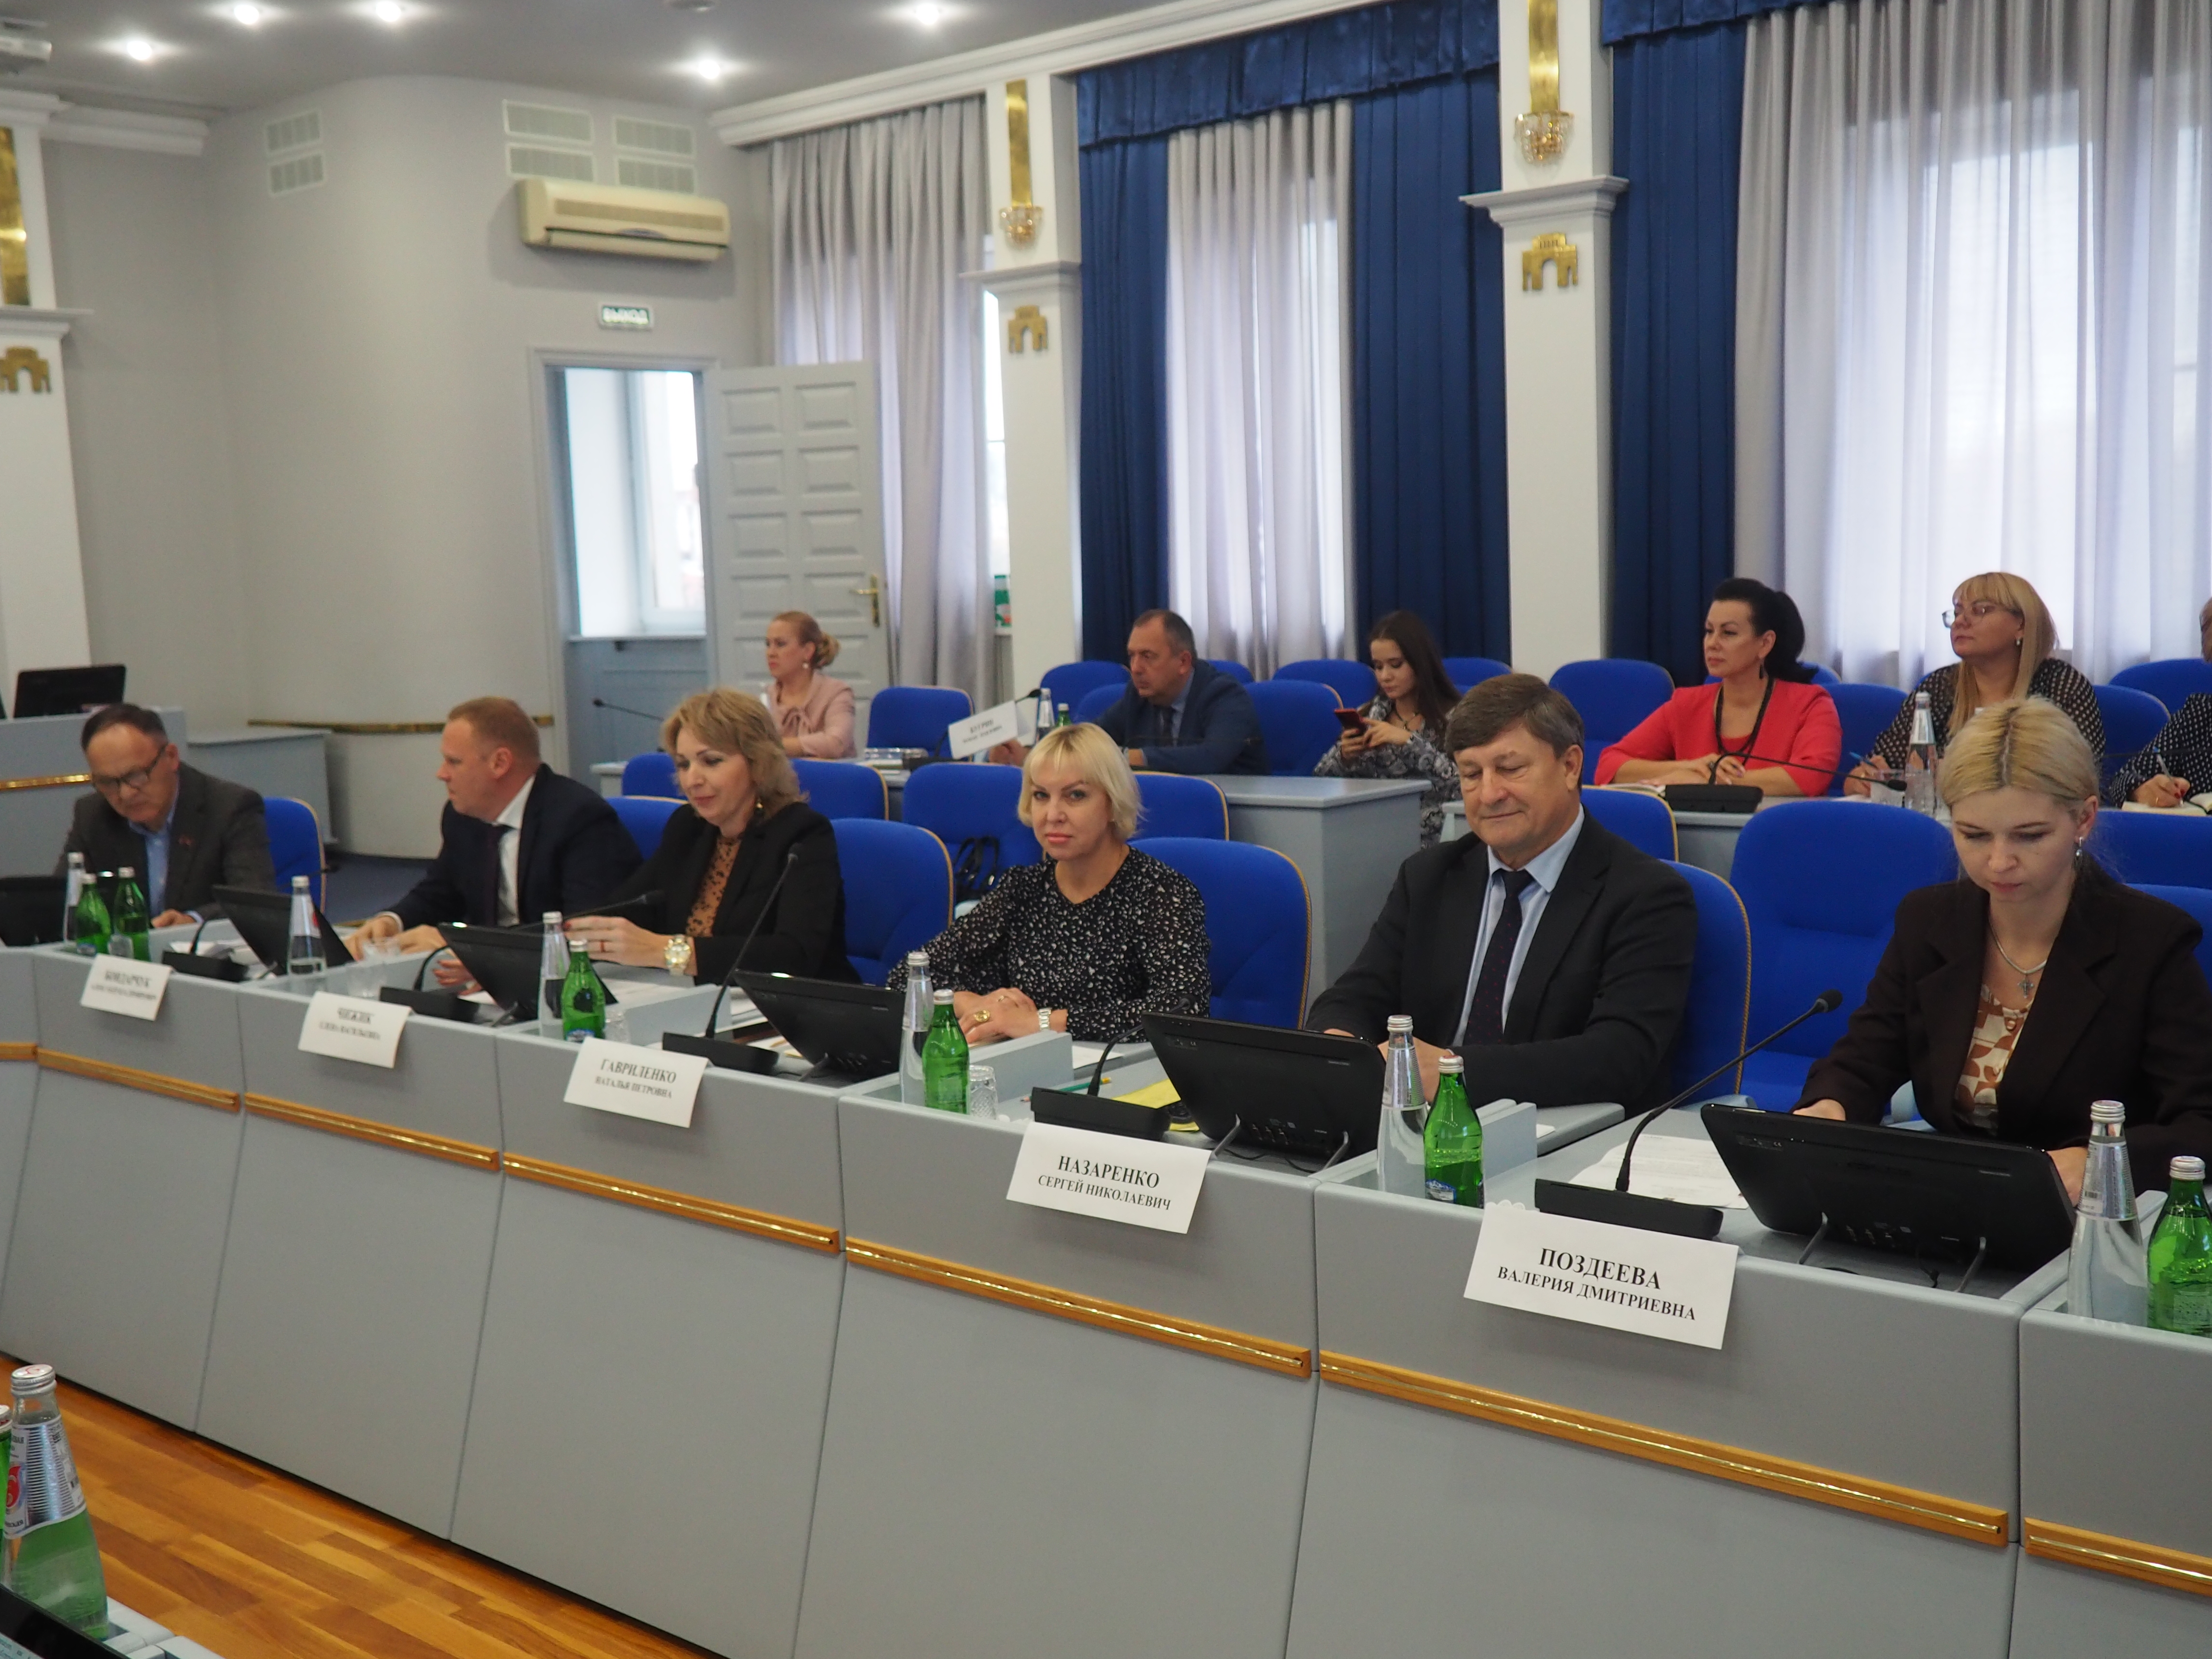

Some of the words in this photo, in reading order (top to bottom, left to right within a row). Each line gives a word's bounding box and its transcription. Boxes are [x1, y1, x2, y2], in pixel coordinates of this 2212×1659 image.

[595, 1076, 630, 1090] НАТАЛЬЯ
[631, 1083, 673, 1098] ПЕТРОВНА
[601, 1059, 677, 1083] ГАВРИЛЕНКО
[1058, 1156, 1160, 1189] НАЗАРЕНКО
[1038, 1175, 1083, 1193] СЕРГЕЙ
[1086, 1184, 1171, 1211] НИКОЛАЕВИЧ
[1539, 1248, 1661, 1290] ПОЗДЕЕВА
[1497, 1266, 1574, 1294] ВАЛЕРИЯ
[1576, 1283, 1695, 1321] ДМИТРИЕВНА
